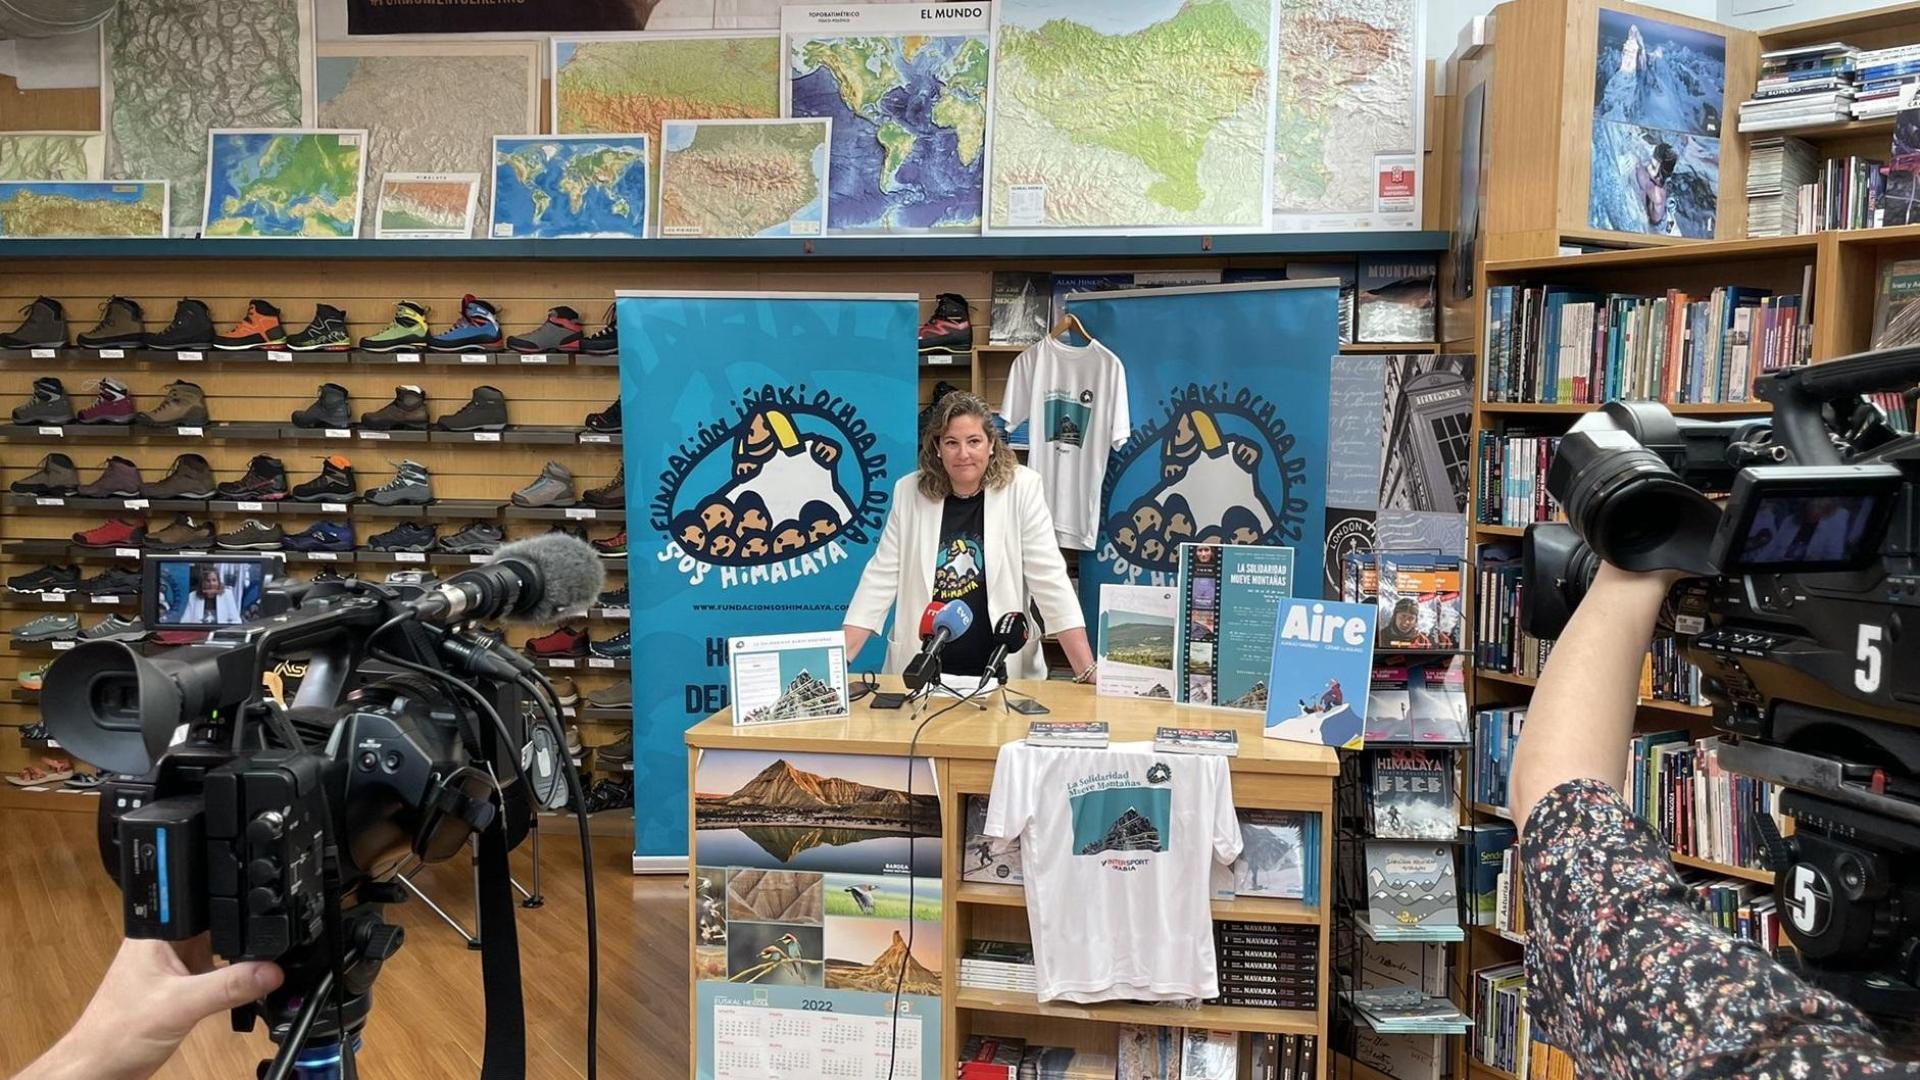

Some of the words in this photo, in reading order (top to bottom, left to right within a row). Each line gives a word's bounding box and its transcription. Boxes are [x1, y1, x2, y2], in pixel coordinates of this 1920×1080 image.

[920, 9, 932, 19] EL
[935, 7, 982, 18] MUNDO
[1368, 265, 1437, 278] MOUNTAINS
[1330, 522, 1362, 550] LONDON
[657, 541, 712, 586] SOS
[1097, 542, 1143, 585] SOS
[1237, 562, 1245, 573] LA
[1246, 563, 1287, 575] SOLIDARIDAD
[1230, 574, 1251, 585] MUEVE
[1252, 574, 1287, 586] MONTAÑAS
[956, 606, 970, 626] tve
[1280, 603, 1367, 646] Aire
[1854, 623, 1882, 693] 5
[1377, 758, 1442, 771] HIMALAYA
[1079, 771, 1129, 785] Solidaridad
[1097, 780, 1141, 790] Montañas
[1500, 880, 1509, 916] Asturias
[1792, 865, 1816, 932] 5
[1244, 924, 1277, 933] NAVARRA
[1246, 937, 1279, 946] NAVARRA
[1244, 950, 1277, 959] NAVARRA
[1244, 961, 1277, 970] NAVARRA
[1244, 974, 1277, 983] NAVARRA
[1244, 987, 1277, 995] NAVARRA
[802, 999, 833, 1012] 2022
[1244, 998, 1278, 1007] NAVARRA
